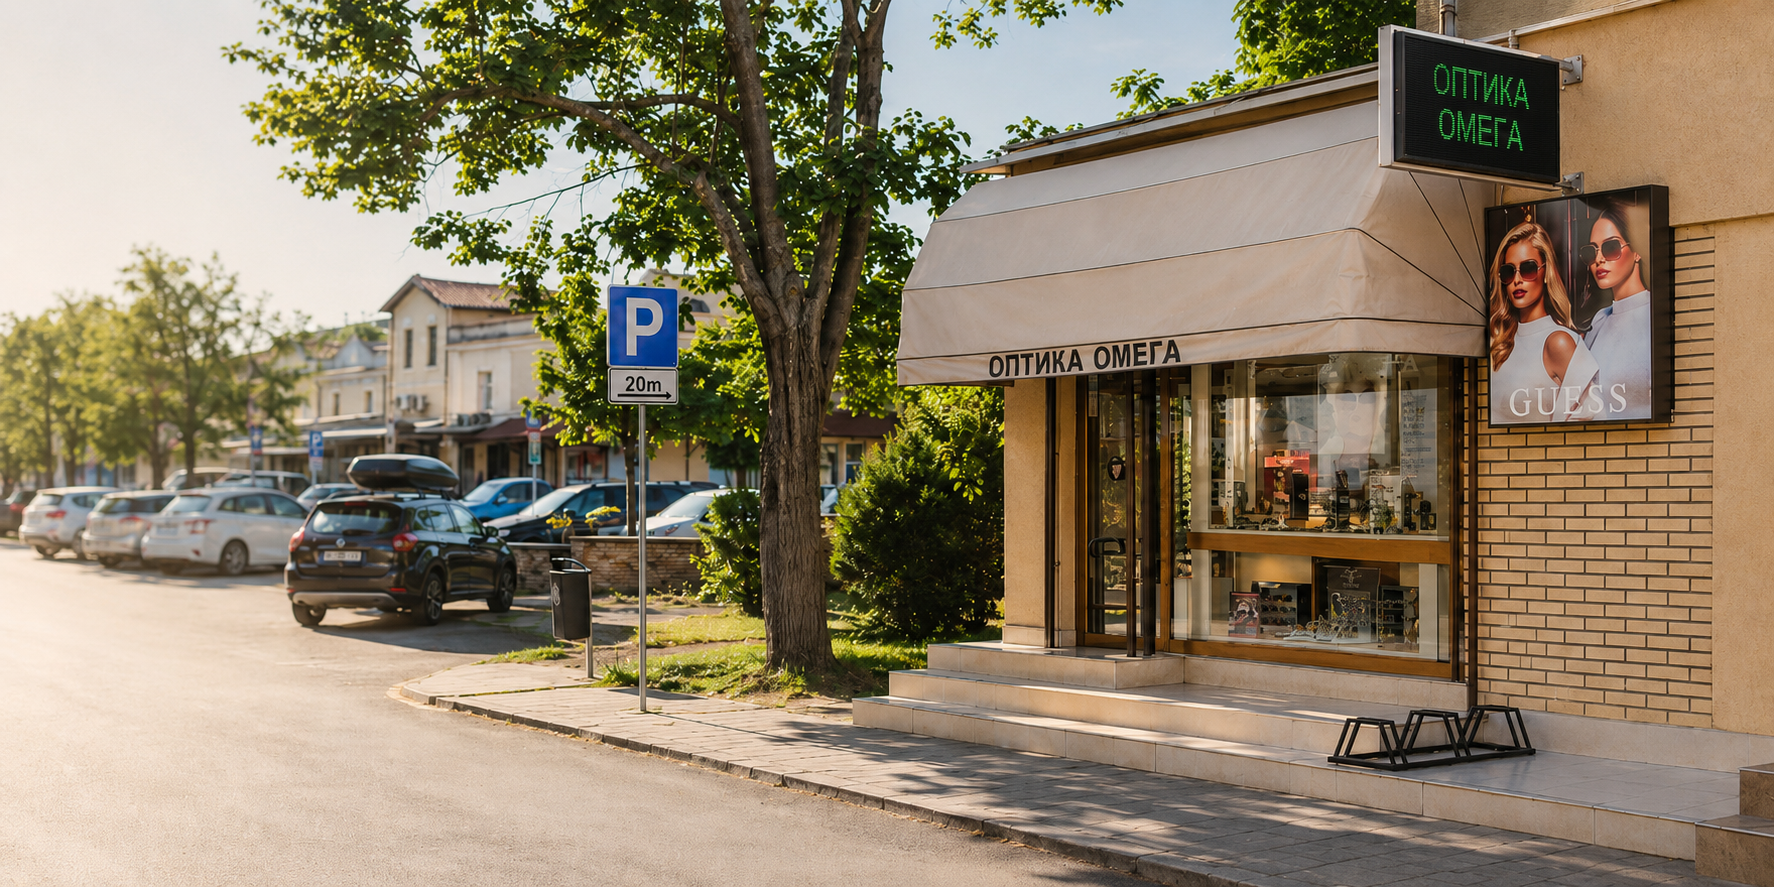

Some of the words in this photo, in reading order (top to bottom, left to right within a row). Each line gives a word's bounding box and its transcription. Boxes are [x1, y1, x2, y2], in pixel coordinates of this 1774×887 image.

[1433, 62, 1530, 110] ОПТИКА
[1438, 108, 1524, 151] ОМЕГА
[626, 297, 664, 356] P
[988, 348, 1084, 378] ОПТИКА
[1093, 339, 1182, 370] ОМЕГА
[625, 375, 662, 392] 20m
[1508, 382, 1628, 418] GUESS
